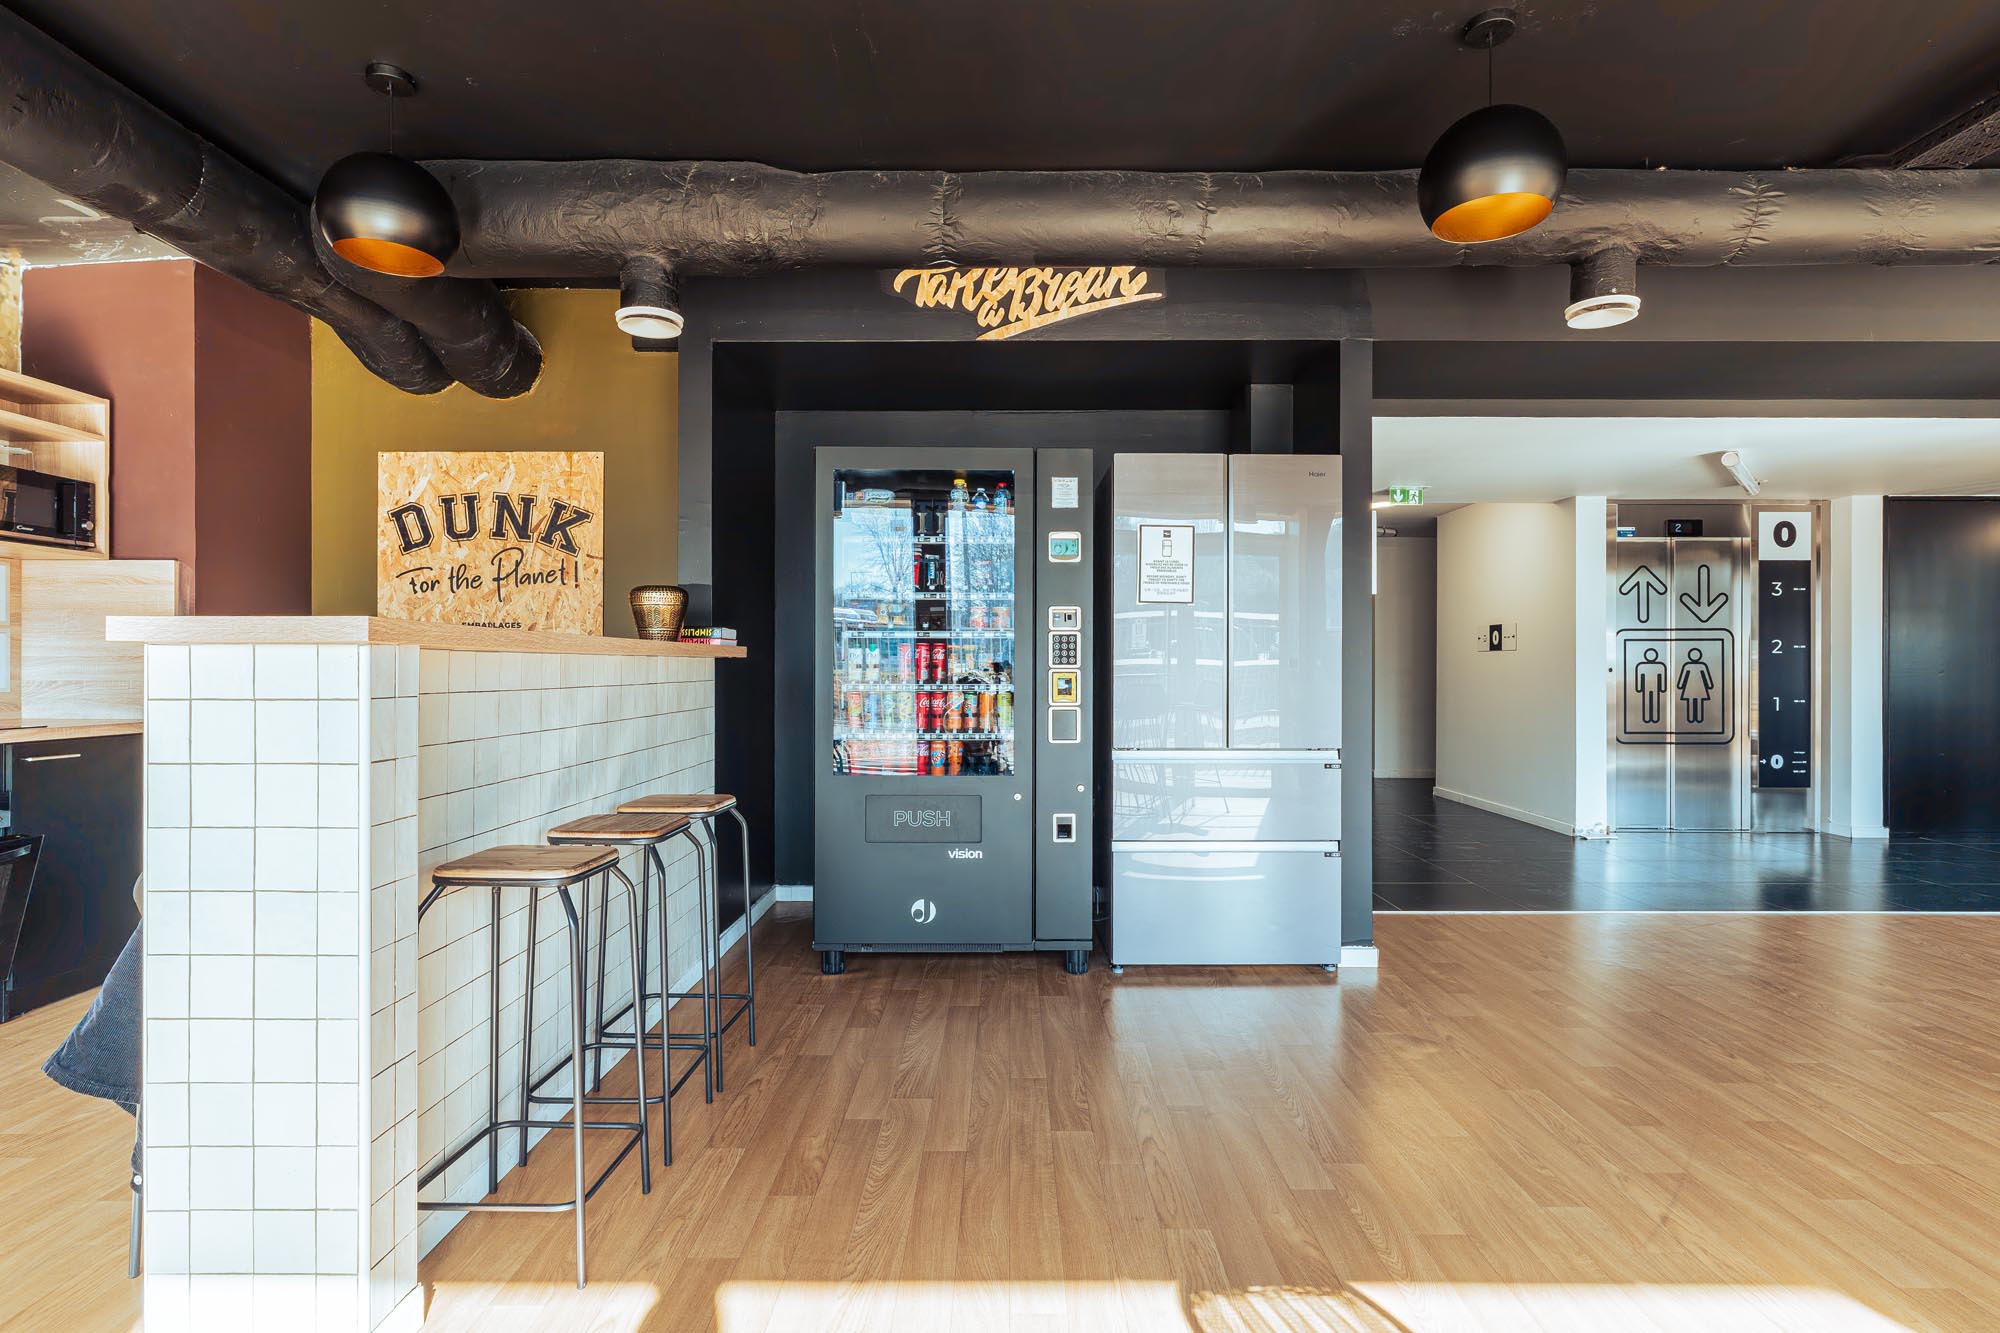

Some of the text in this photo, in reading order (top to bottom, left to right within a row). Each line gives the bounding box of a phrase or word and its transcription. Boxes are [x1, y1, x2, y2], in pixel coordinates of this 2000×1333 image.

[1308, 470, 1327, 478] Haier
[387, 491, 595, 557] DUNK
[1674, 523, 1682, 533] 2
[1773, 520, 1797, 548] 0
[396, 566, 440, 595] For
[447, 563, 483, 594] the
[1771, 581, 1783, 597] 3
[1492, 630, 1499, 645] 0
[1771, 639, 1783, 654] 2
[1772, 696, 1780, 711] 1
[1770, 754, 1784, 769] 0
[893, 810, 951, 827] PUSH
[947, 848, 983, 859] vision
